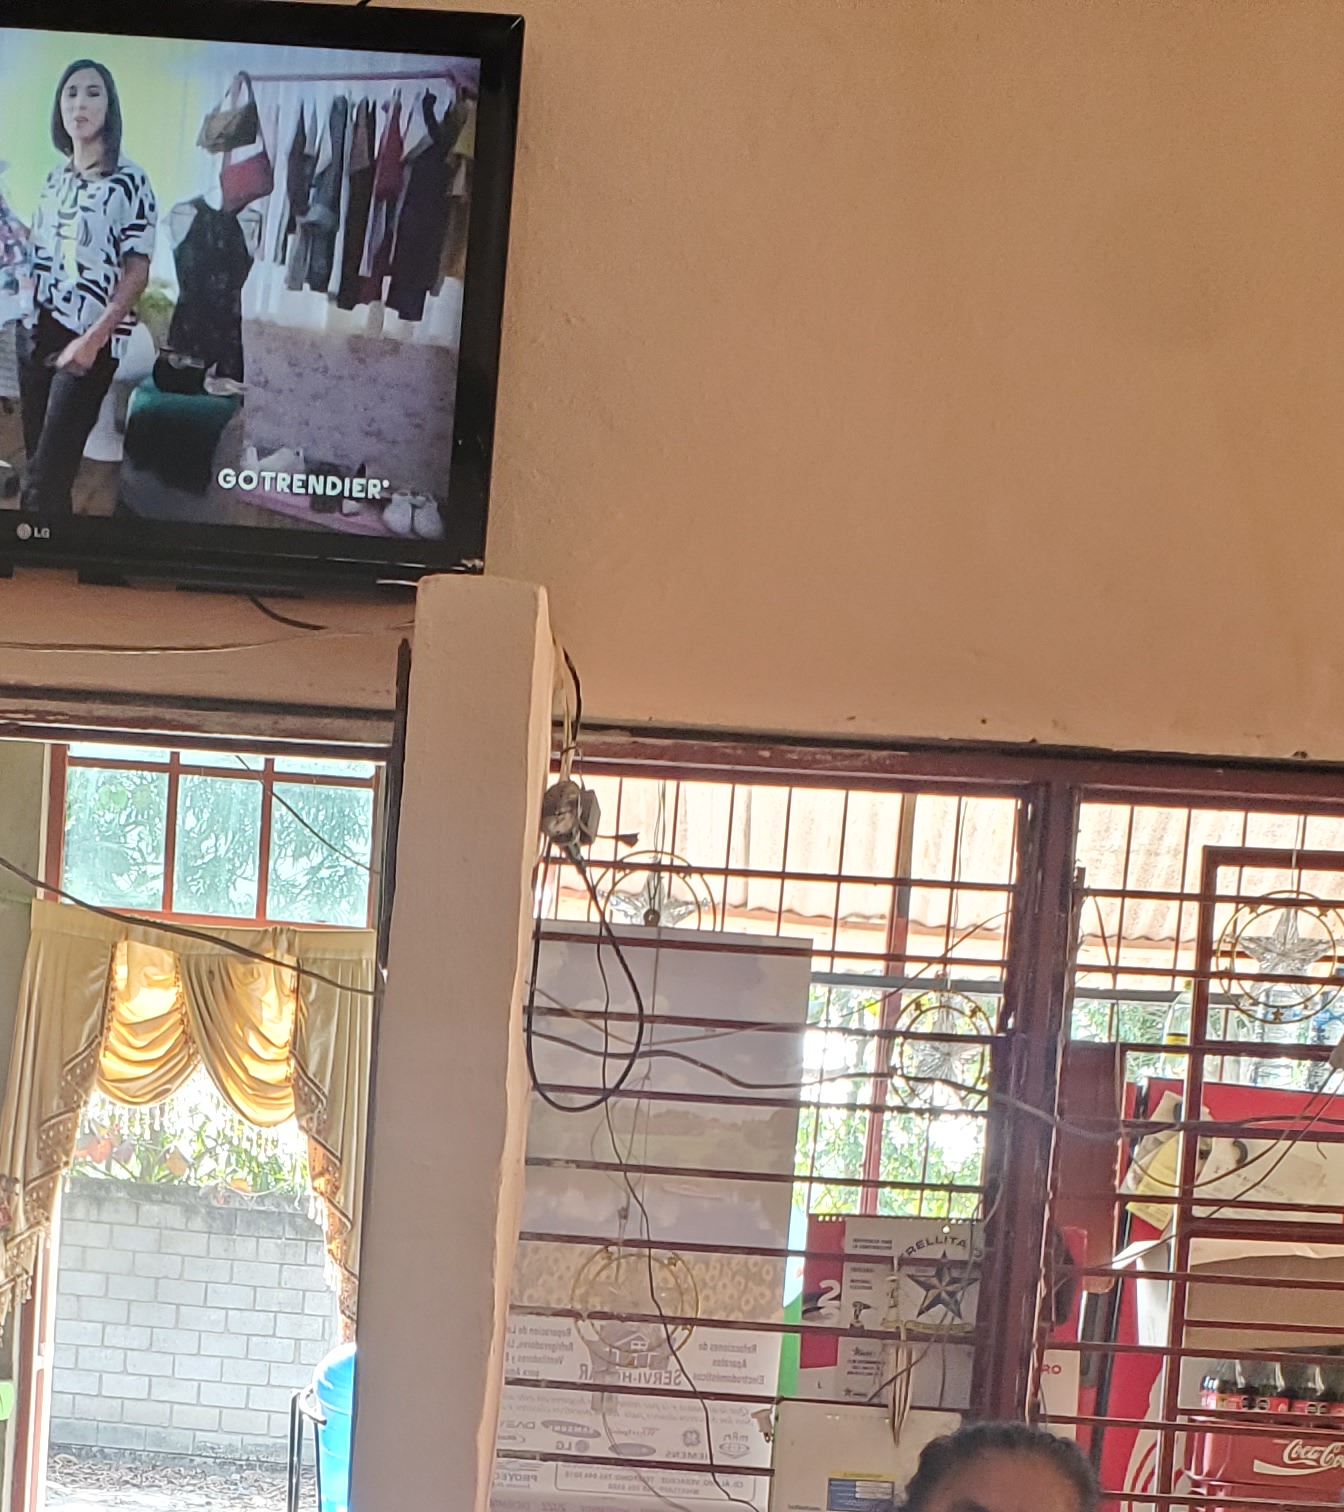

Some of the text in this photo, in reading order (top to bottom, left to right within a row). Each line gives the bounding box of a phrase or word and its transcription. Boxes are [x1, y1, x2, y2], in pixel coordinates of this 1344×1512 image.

[217, 468, 383, 499] GOTRENDIER
[33, 527, 50, 539] LG
[899, 1236, 968, 1258] RELLITA
